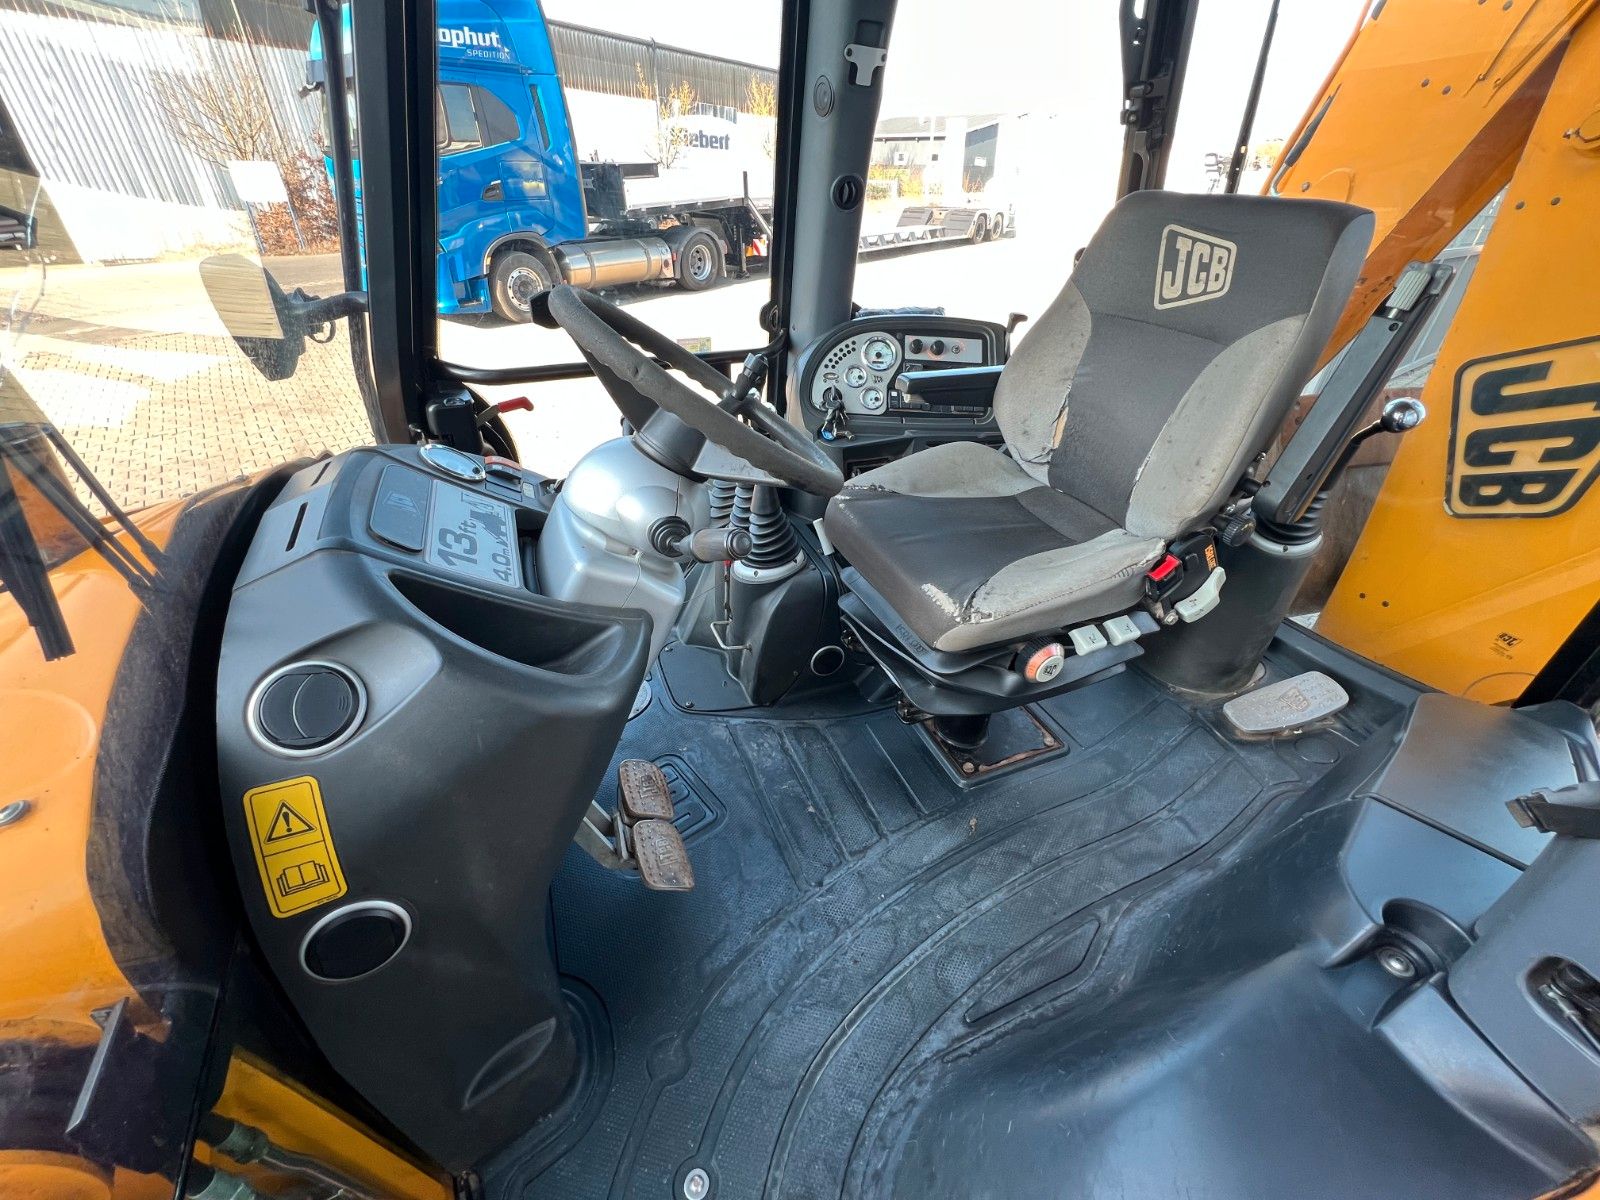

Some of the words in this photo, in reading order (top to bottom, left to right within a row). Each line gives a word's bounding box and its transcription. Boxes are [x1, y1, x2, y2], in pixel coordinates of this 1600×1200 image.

[466, 48, 511, 60] SPEDITION
[1162, 236, 1229, 300] JCB
[1459, 360, 1600, 507] JCB
